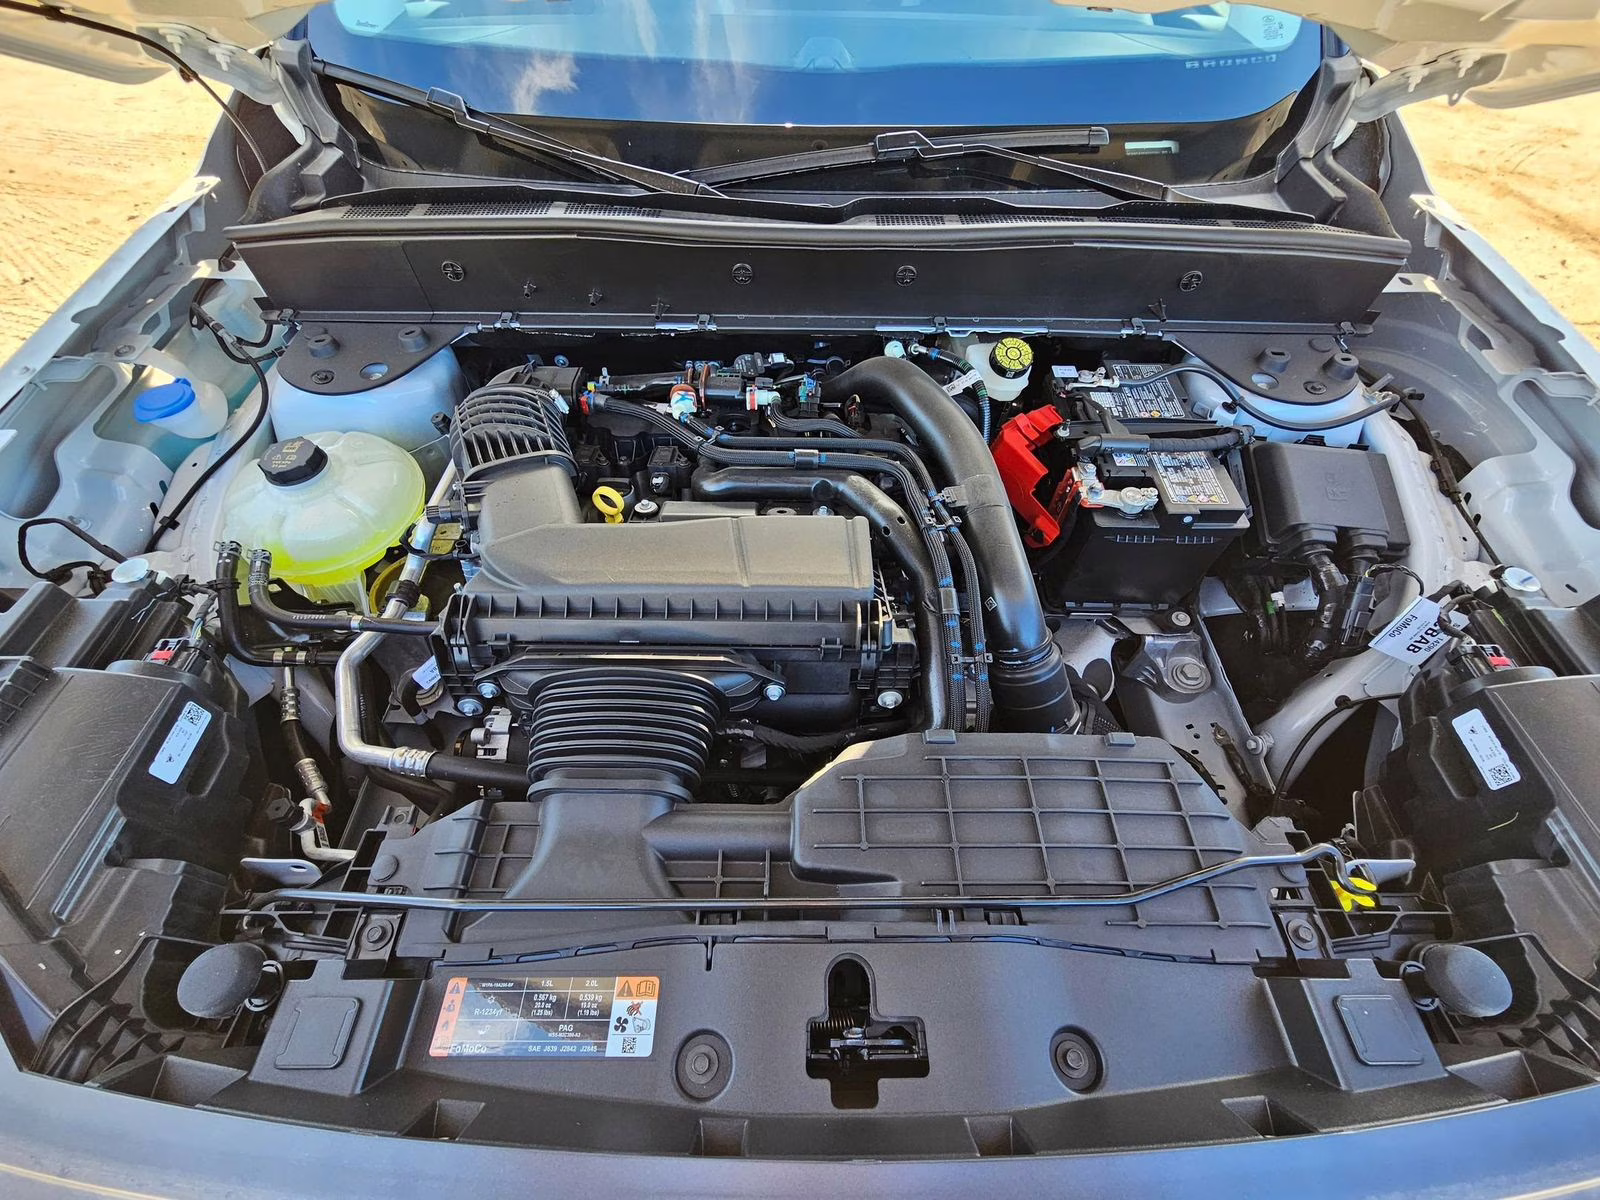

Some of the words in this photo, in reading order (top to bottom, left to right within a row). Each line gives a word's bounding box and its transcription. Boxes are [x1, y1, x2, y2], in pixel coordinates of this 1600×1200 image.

[1389, 614, 1418, 637] FoMoCo
[549, 993, 557, 1002] kg
[595, 993, 603, 1002] kg
[449, 1043, 487, 1053] FoMoCo
